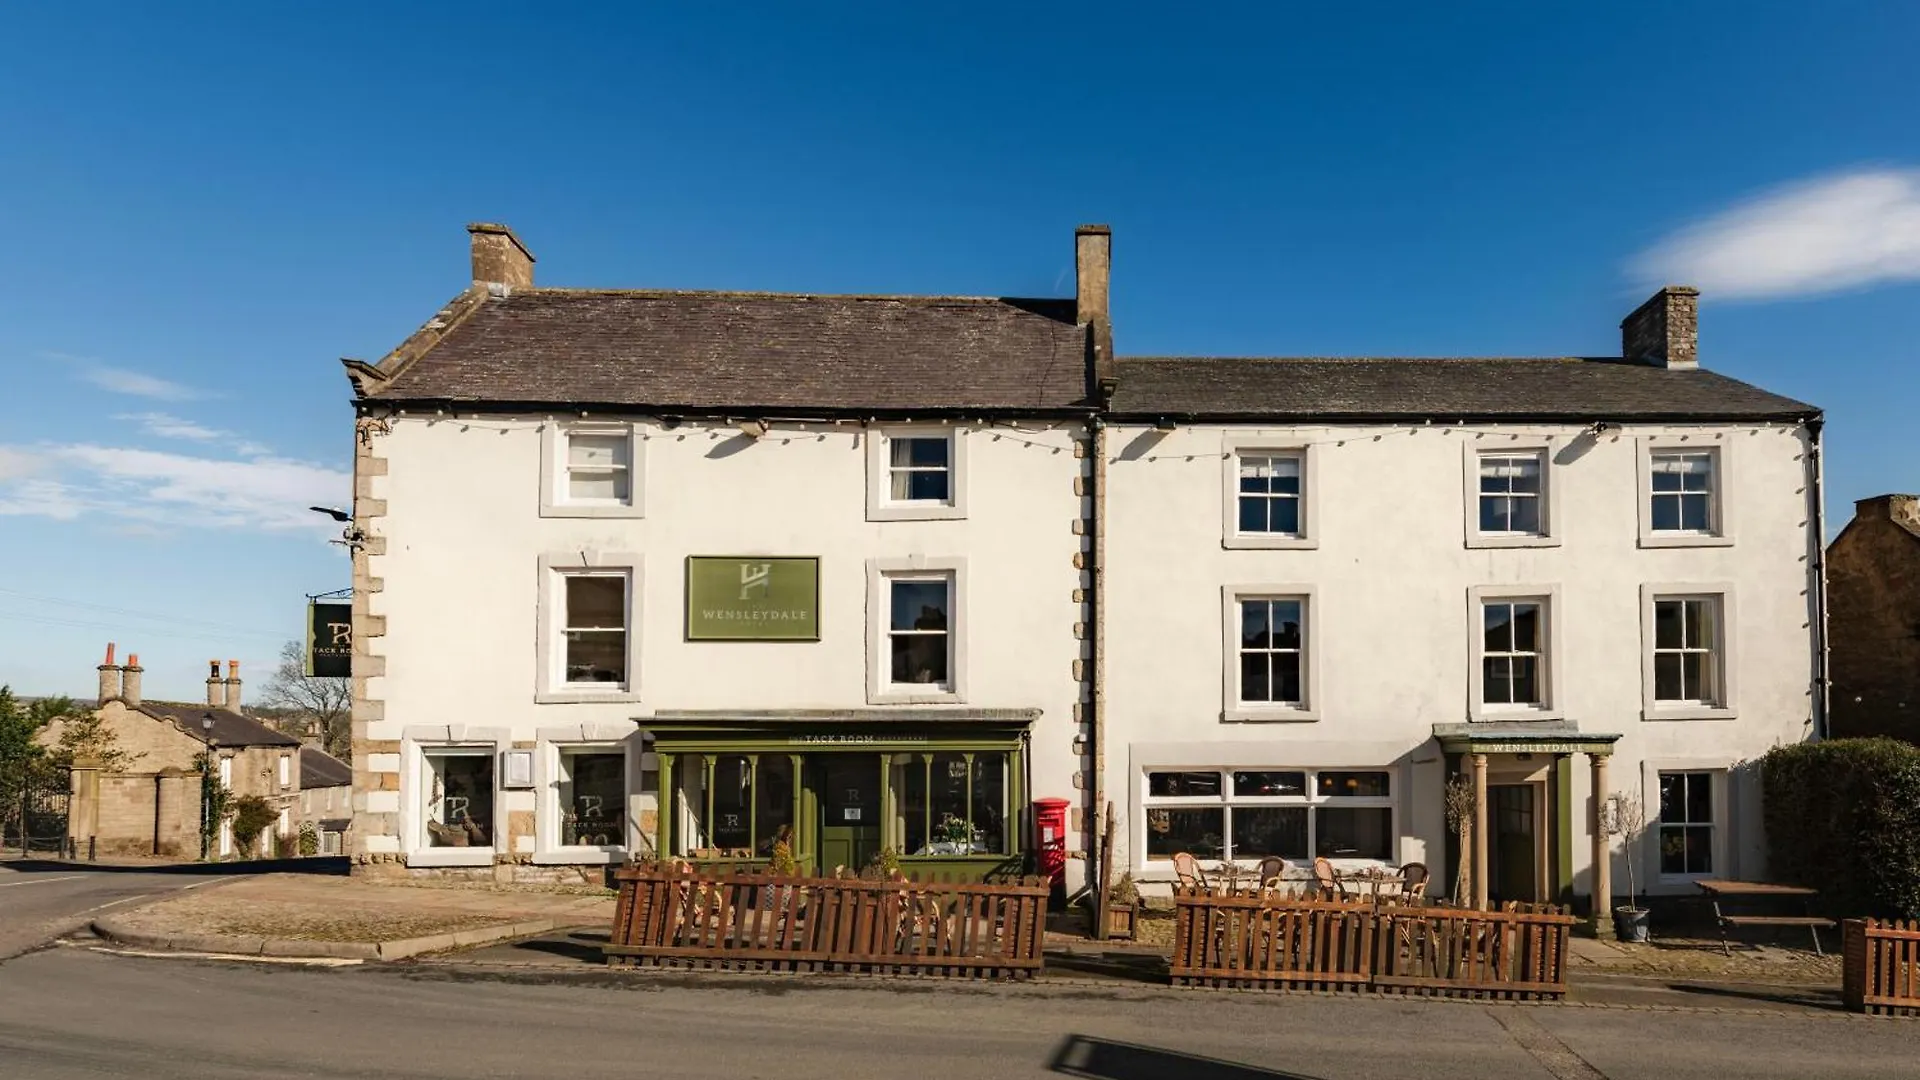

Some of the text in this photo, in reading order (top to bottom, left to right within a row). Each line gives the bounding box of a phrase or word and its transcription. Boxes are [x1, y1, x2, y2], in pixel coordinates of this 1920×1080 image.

[702, 609, 808, 620] WENSLEYDALE
[805, 734, 835, 743] TACK
[840, 734, 874, 743] ROOM
[1492, 744, 1583, 753] WENSLEYDALE
